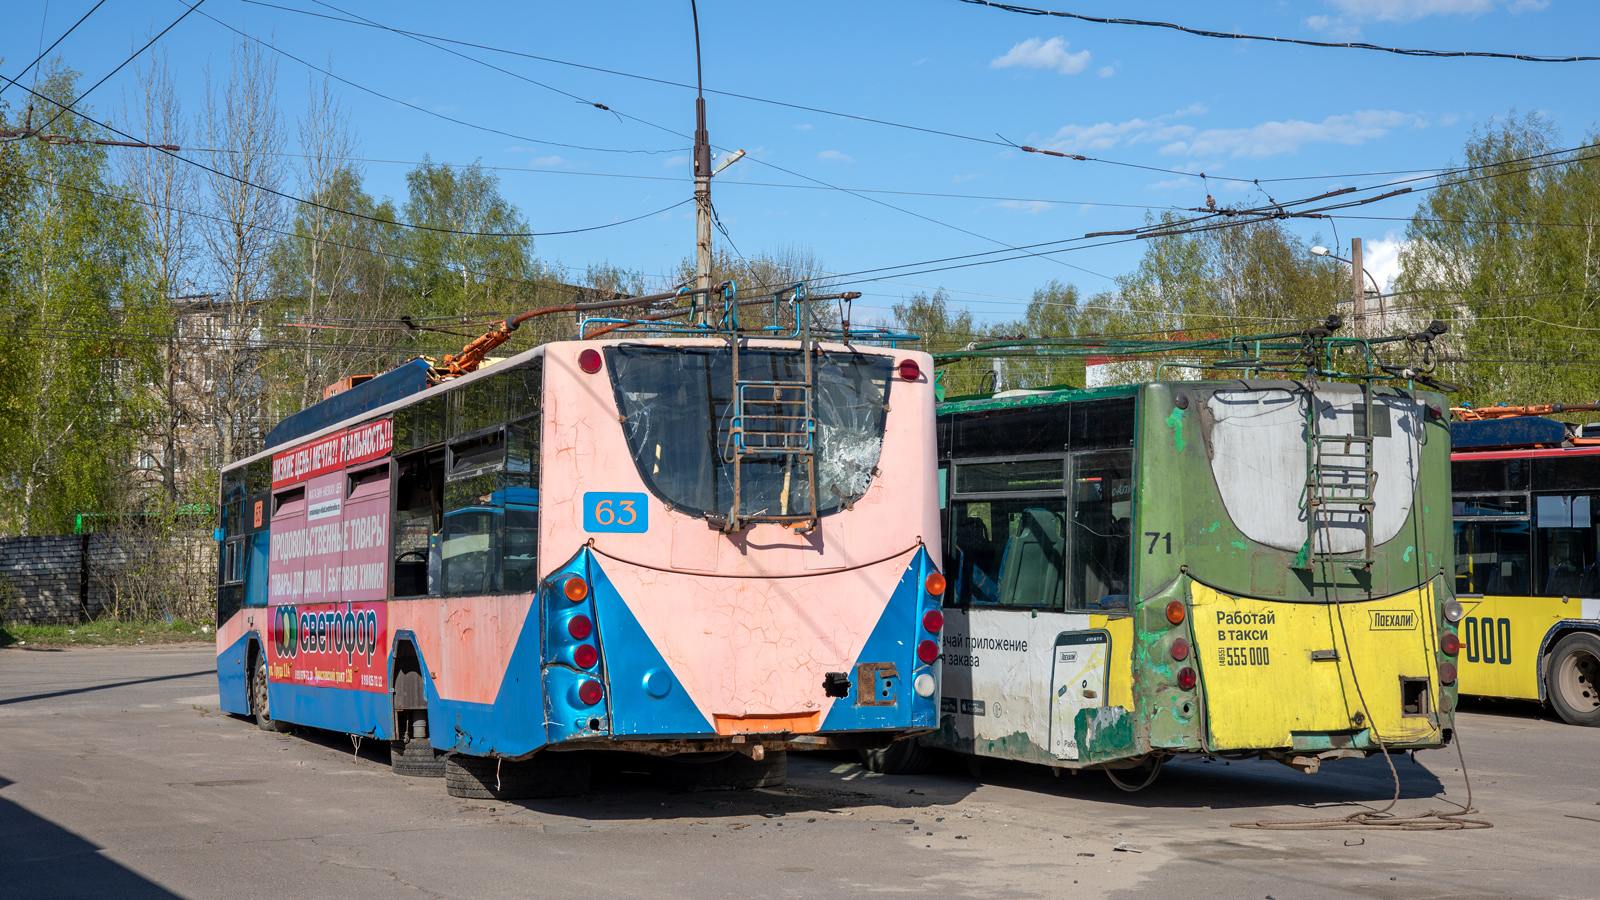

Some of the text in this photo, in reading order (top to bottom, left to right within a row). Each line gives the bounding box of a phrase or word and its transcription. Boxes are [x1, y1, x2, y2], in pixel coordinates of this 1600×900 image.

[272, 454, 294, 482] НИЗКИЕ
[295, 445, 312, 480] ЦЕНЫ
[312, 439, 339, 471] МЕЧТА?!
[595, 500, 637, 525] 63
[272, 513, 386, 565] ПРОДОВОЛЬСТВЕННЫЕ ТОВАРЫ
[1145, 532, 1171, 554] 71
[271, 572, 293, 596] ТОВАРЫ
[304, 569, 322, 598] ДОМА
[328, 564, 358, 592] БЫТОВАЯ
[359, 562, 385, 590] ХИМИЯ
[1216, 610, 1276, 625] Работай
[301, 600, 377, 668] светофор
[942, 633, 1028, 652] ачай приложение
[1218, 630, 1268, 641] в такси
[948, 654, 980, 668] заказа
[1226, 647, 1247, 666] 555
[1249, 647, 1270, 666] 000
